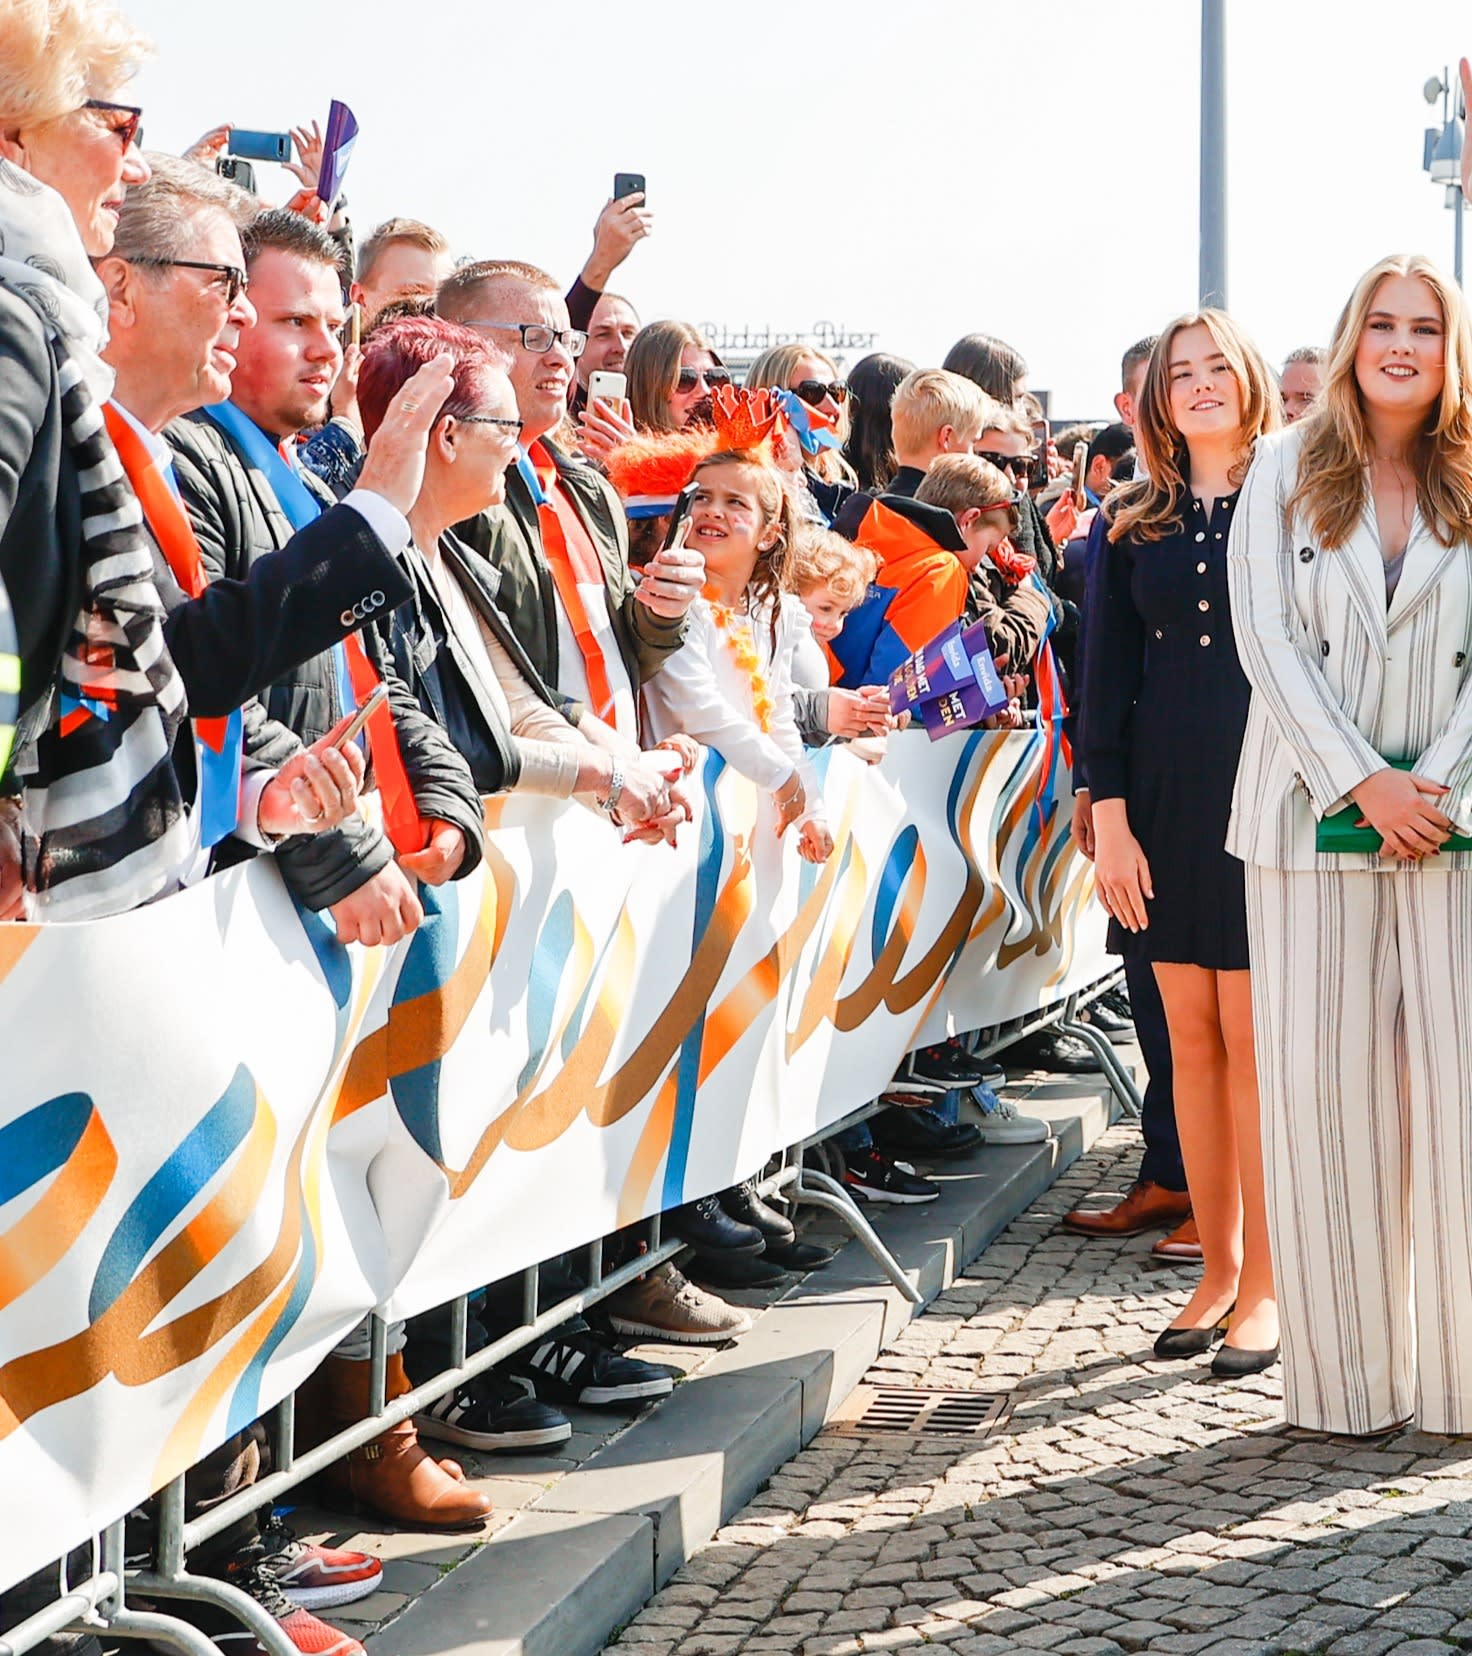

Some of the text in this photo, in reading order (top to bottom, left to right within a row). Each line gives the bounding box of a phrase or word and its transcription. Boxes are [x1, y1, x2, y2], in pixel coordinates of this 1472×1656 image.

[813, 320, 880, 349] Bier
[977, 656, 993, 693] Envida
[949, 691, 966, 719] MET
